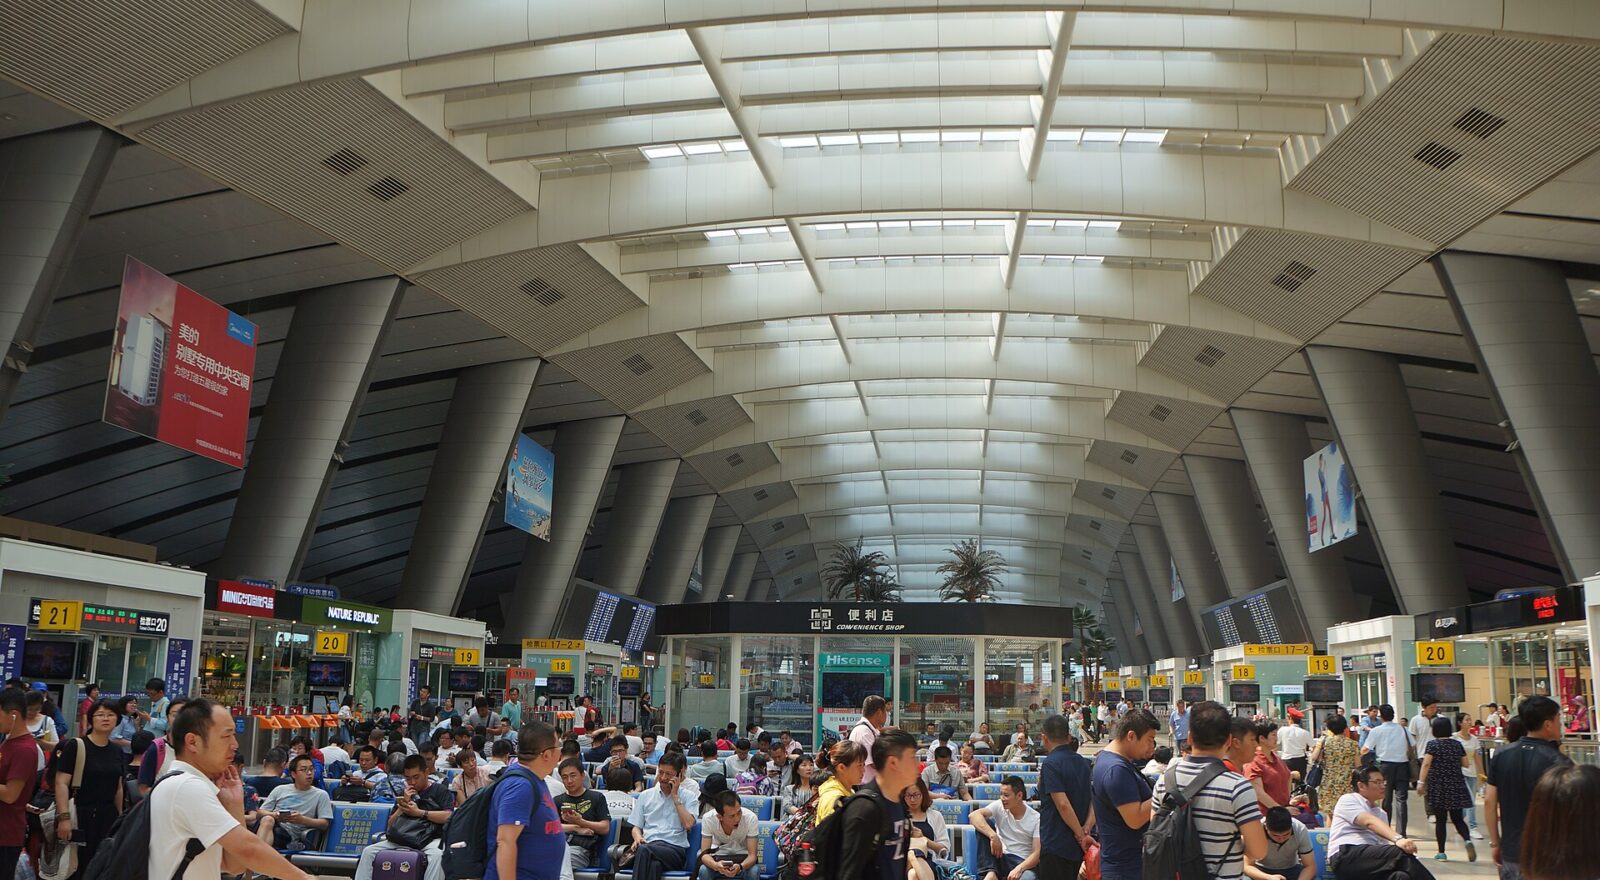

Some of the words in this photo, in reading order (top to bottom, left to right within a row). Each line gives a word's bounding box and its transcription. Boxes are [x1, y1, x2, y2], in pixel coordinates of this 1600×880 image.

[179, 323, 200, 346] 美的
[175, 343, 250, 391] 别墅专用中央空调
[49, 607, 68, 625] 21
[328, 606, 352, 621] NATURE
[353, 610, 380, 625] REPUBLIC
[848, 608, 894, 622] 便利店
[155, 618, 167, 632] 20
[323, 637, 339, 650] 20
[460, 651, 473, 663] 19
[826, 654, 882, 666] Hisense
[1426, 646, 1446, 661] 20
[556, 661, 566, 671] 18
[1316, 660, 1329, 671] 19
[1189, 673, 1198, 682] 17
[1238, 667, 1249, 678] 18
